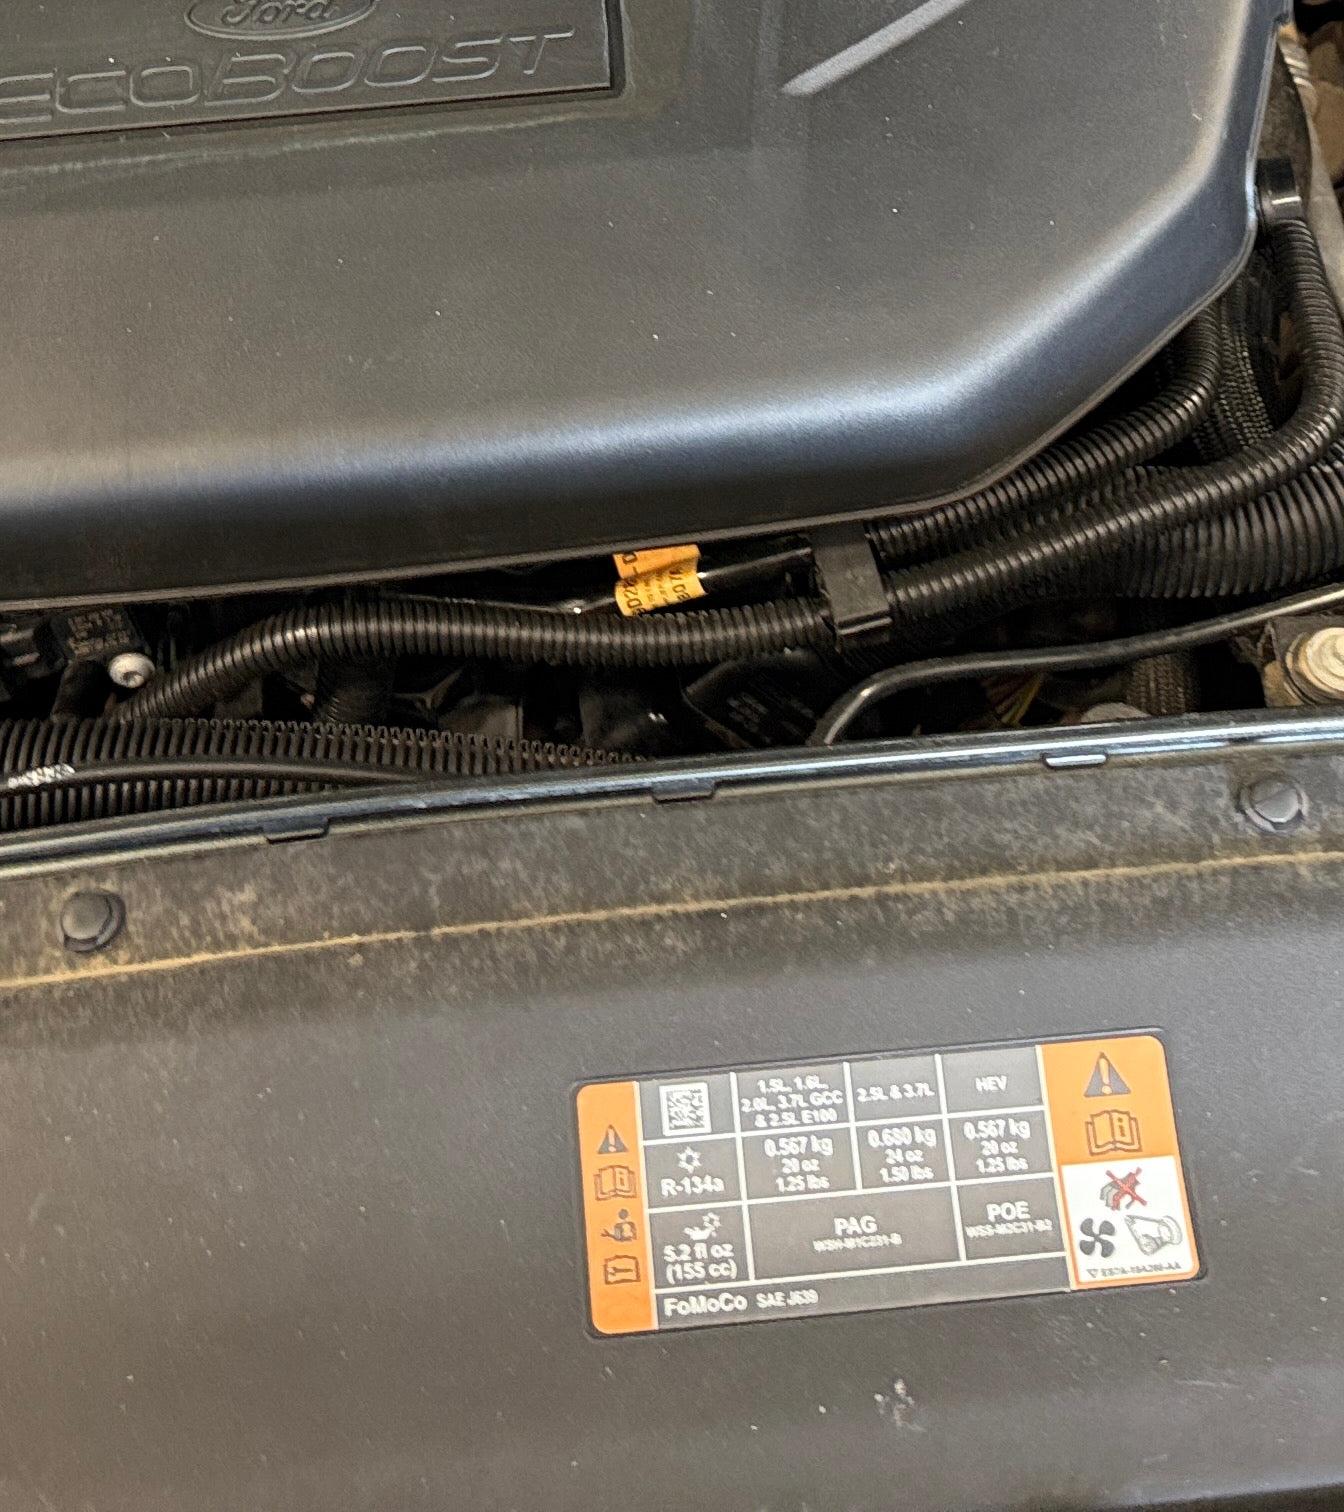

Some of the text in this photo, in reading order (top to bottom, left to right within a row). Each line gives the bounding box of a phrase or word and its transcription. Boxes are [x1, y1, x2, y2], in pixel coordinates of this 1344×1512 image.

[856, 1082, 936, 1102] 2.5L & 3.7L
[975, 1075, 1008, 1094] HEV
[809, 1090, 843, 1106] GCC
[754, 1108, 838, 1128] & 2.5L E100
[867, 1125, 937, 1148] 0.680 kg
[963, 1117, 1031, 1140] 0.567 kg
[764, 1134, 834, 1157] 0.567 kg
[980, 1140, 1019, 1156] 20 oz
[781, 1158, 820, 1174] 20 oz
[884, 1148, 925, 1165] 24 oz
[975, 1156, 1029, 1173] 1.25 lbs
[776, 1174, 830, 1193] 1.25 lbs
[879, 1164, 935, 1183] 1.50 lbs
[660, 1174, 725, 1198] R-134a
[986, 1200, 1031, 1223] POE
[833, 1215, 878, 1236] PAG
[663, 1243, 735, 1262] 5.2 fl oz
[666, 1258, 738, 1285] (155 cc)
[663, 1292, 748, 1317] FoMoCo
[756, 1291, 787, 1309] SAE
